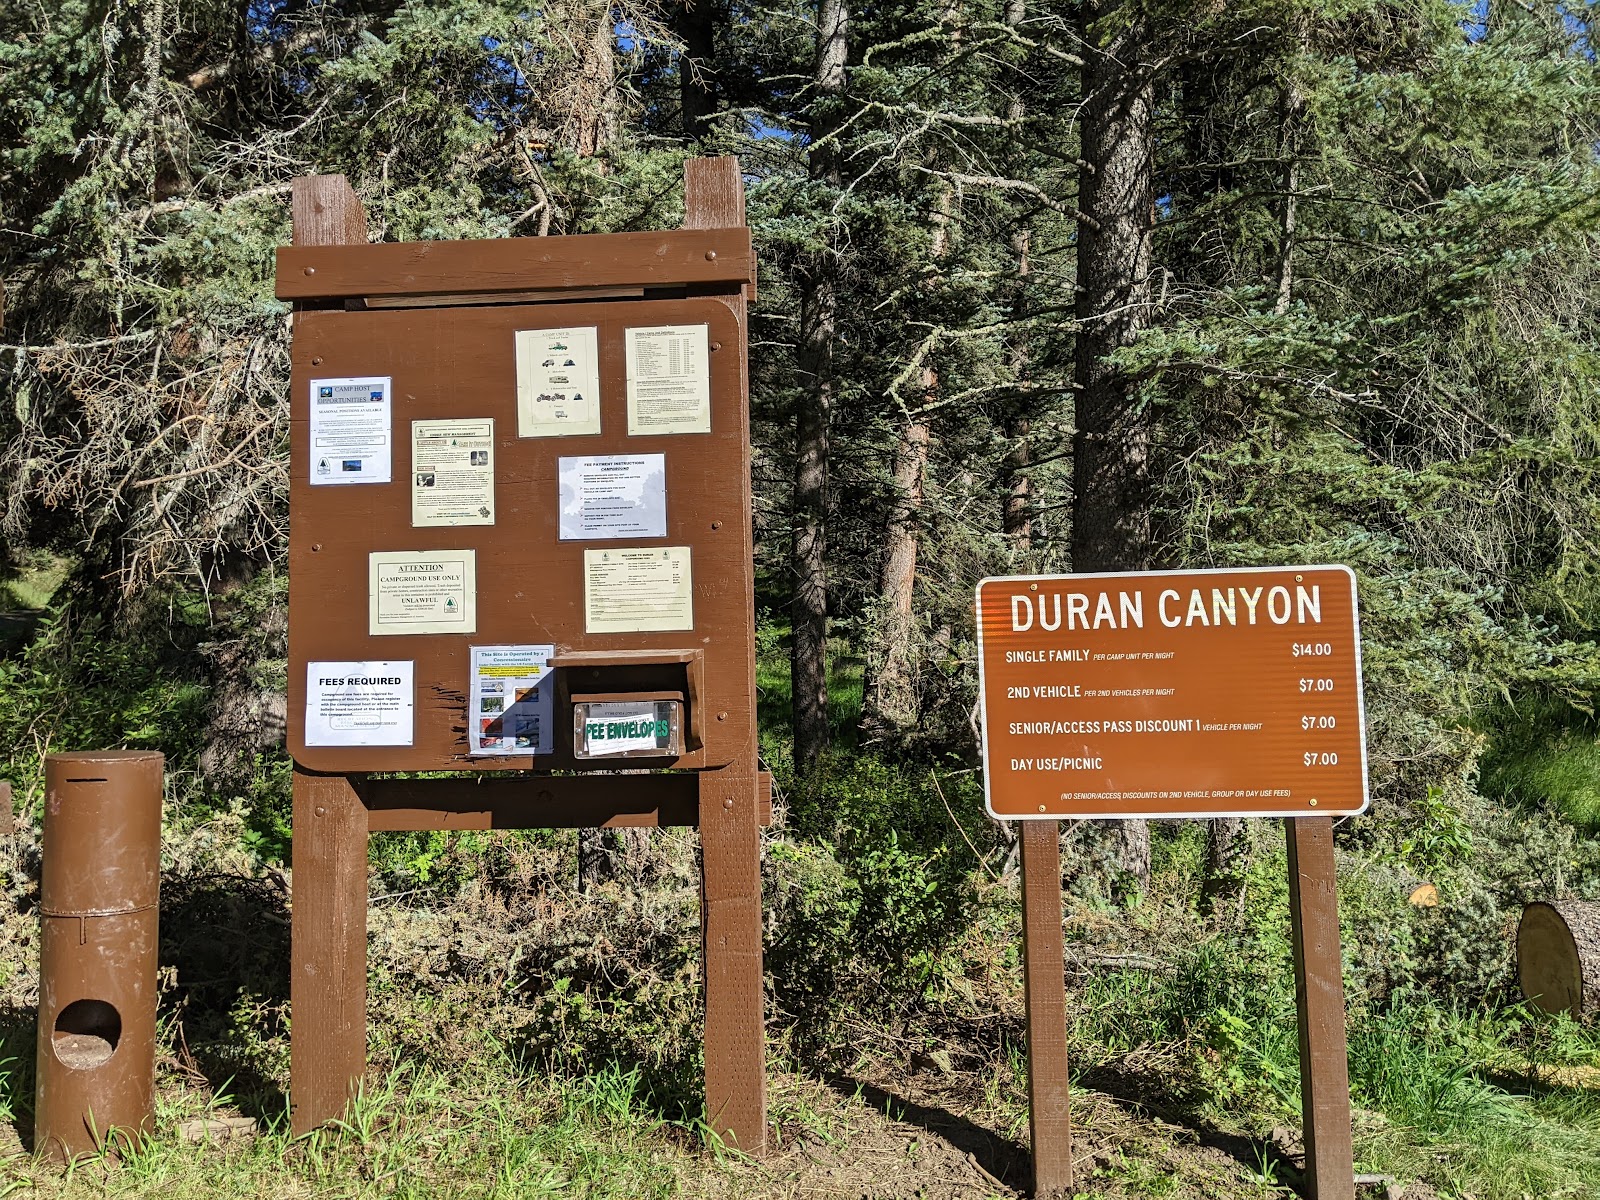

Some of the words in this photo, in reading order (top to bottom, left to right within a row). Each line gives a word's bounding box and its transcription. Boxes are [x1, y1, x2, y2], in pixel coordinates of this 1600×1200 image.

[1011, 591, 1144, 631] DURAN
[1159, 585, 1321, 628] CANYON
[1006, 650, 1046, 662] SINGLE
[1049, 649, 1090, 662] FAMILY
[1292, 642, 1332, 657] $14.00
[1007, 687, 1030, 698] 2ND
[1033, 686, 1081, 698] VEHICLE
[1300, 678, 1333, 693] $7.00
[607, 720, 669, 740] ENVELOPES
[1009, 721, 1100, 735] SENIOR/ACCESS
[1103, 721, 1132, 732] PASS
[1136, 720, 1193, 732] DISCOUNT
[1196, 720, 1200, 731] 1
[1302, 715, 1336, 730] $7.00
[1011, 759, 1033, 770] DAY
[1036, 757, 1102, 771] USE/PICNIC
[1303, 752, 1338, 767] $7.00
